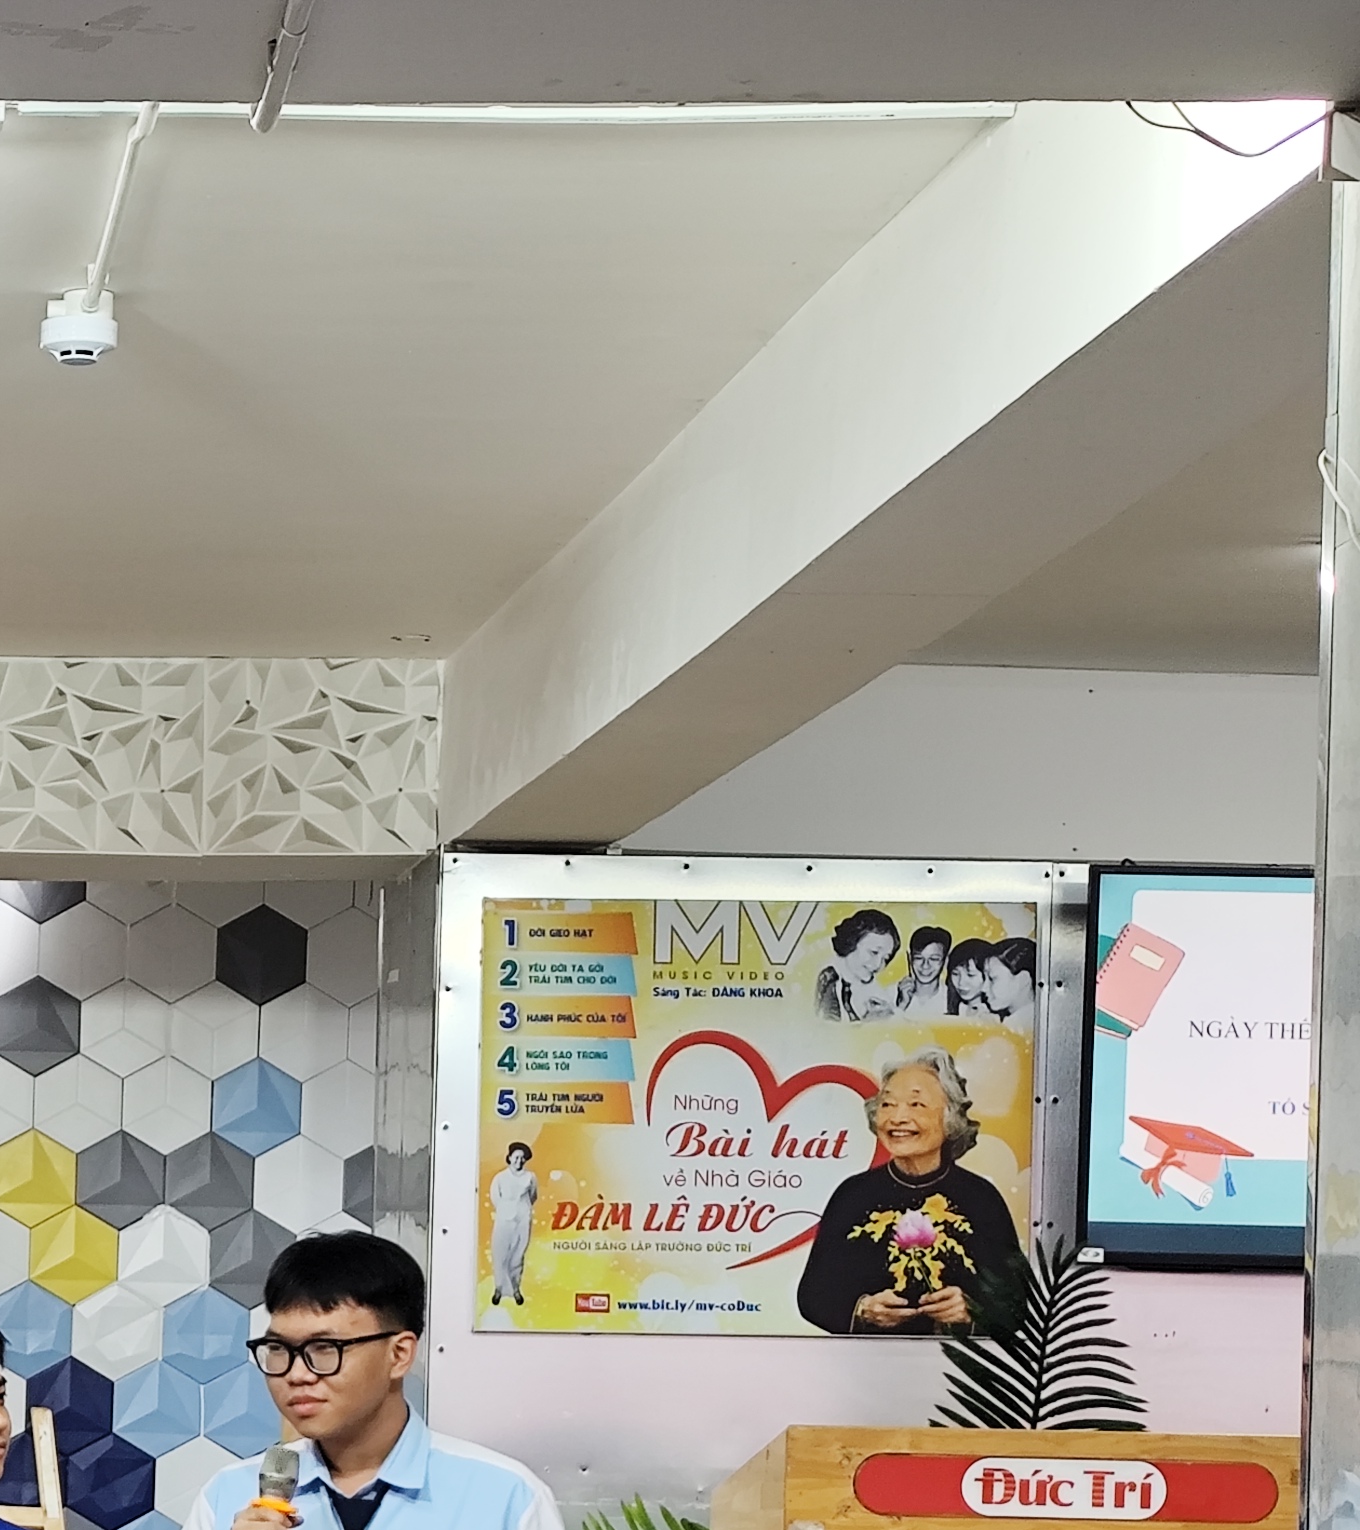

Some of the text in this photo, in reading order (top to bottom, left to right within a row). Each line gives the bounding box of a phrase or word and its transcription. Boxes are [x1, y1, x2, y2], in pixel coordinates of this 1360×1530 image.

[502, 918, 518, 946] 1
[653, 900, 819, 965] MV
[499, 959, 519, 987] 2
[555, 975, 573, 985] TIM
[576, 975, 596, 985] CHO
[652, 969, 786, 982] MUSIC VIDEO
[652, 986, 680, 999] Sáng
[749, 987, 784, 999] KHOA
[499, 1002, 517, 1029] 3
[1188, 1015, 1259, 1040] NGÀY
[497, 1046, 517, 1073] 4
[552, 1050, 573, 1060] SAO
[497, 1089, 516, 1116] 5
[674, 1093, 739, 1115] Những
[665, 1121, 849, 1159] Bài hát
[693, 1168, 740, 1188] Nhà
[747, 1168, 803, 1188] Giáo
[551, 1193, 776, 1233] ĐÀM LÊ ĐỨC
[974, 1467, 1155, 1509] Đức Trí
